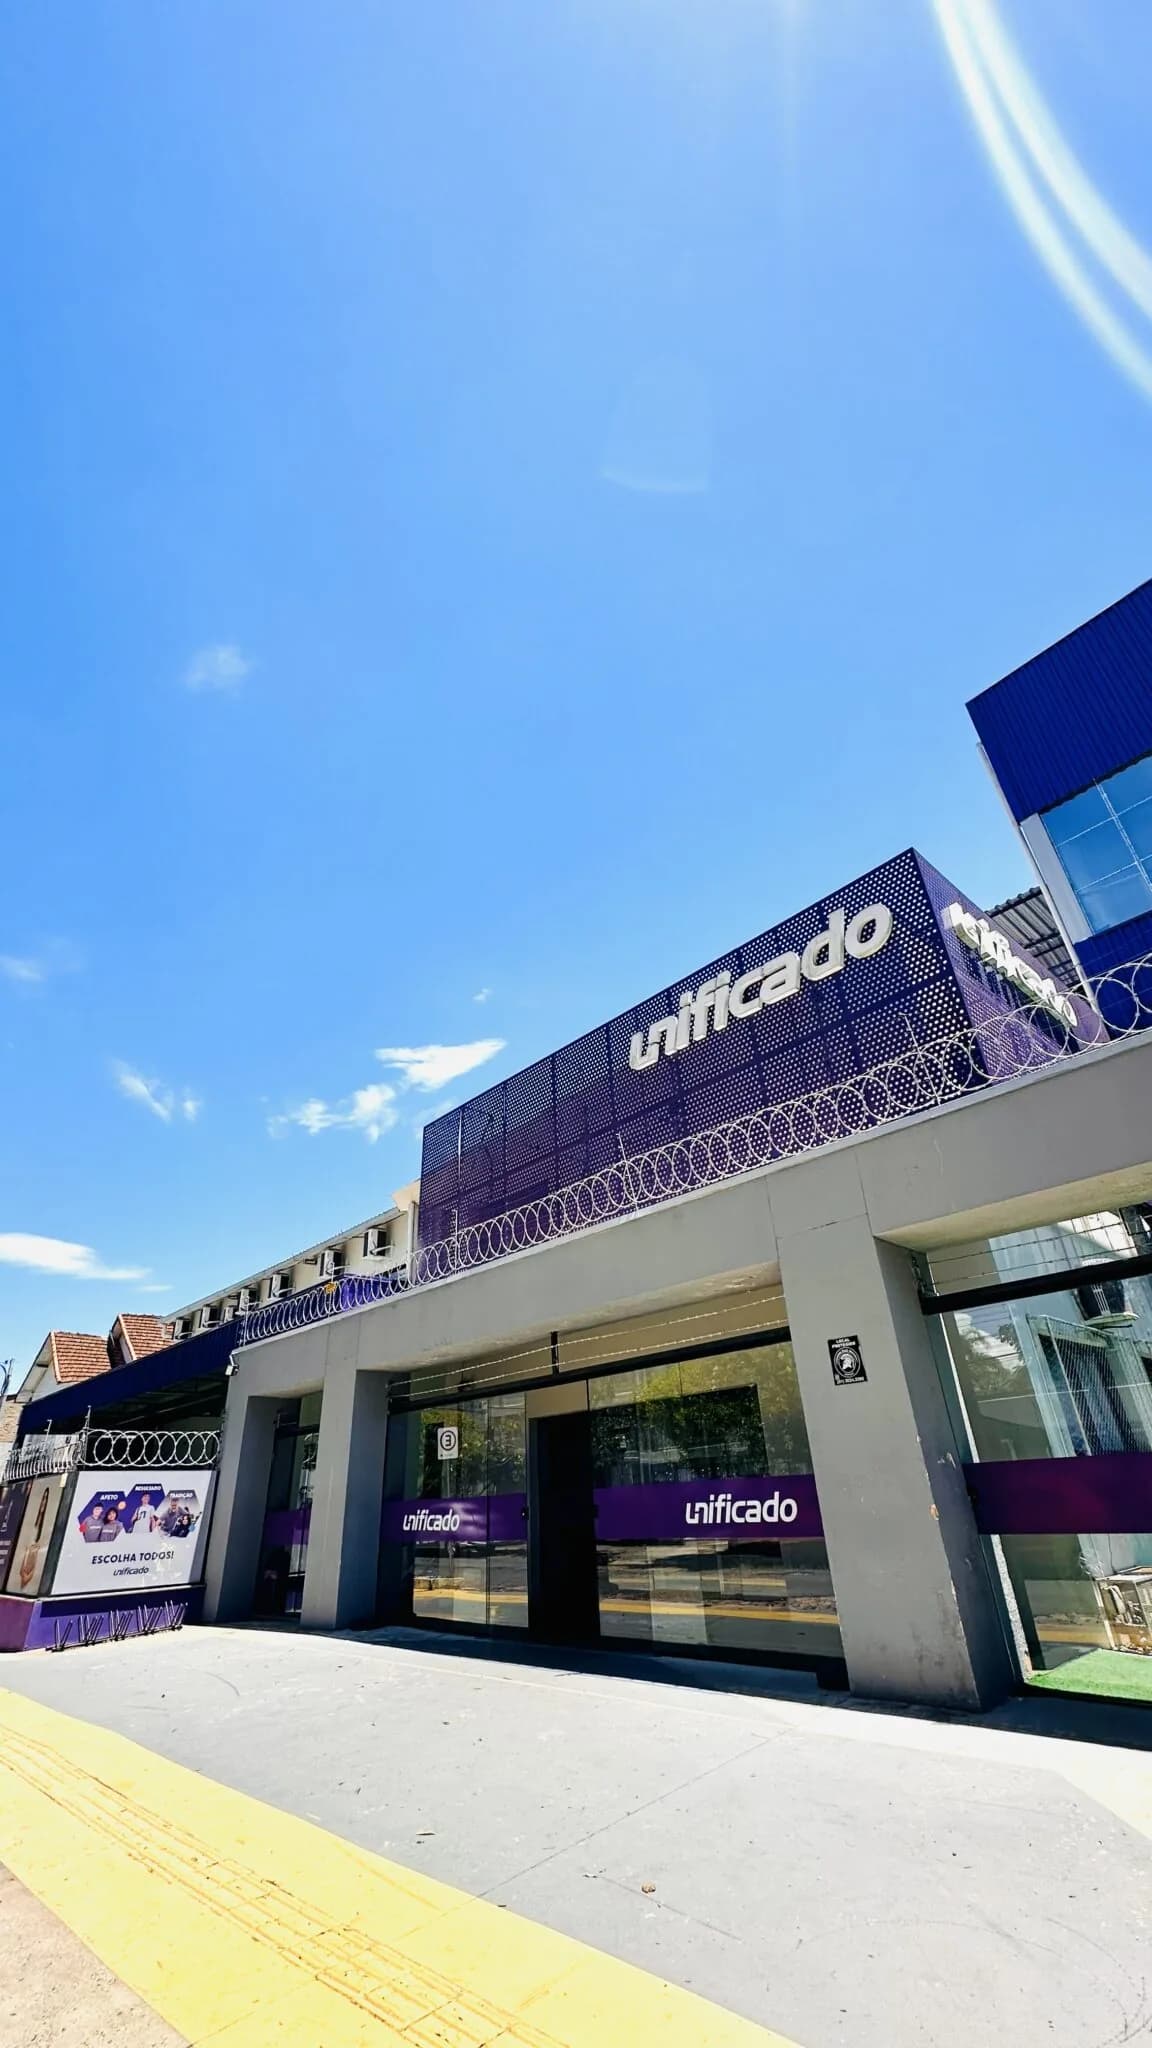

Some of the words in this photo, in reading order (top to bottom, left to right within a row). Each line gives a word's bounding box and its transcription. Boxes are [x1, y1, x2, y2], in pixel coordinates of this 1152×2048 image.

[629, 902, 893, 1071] unificado
[685, 1491, 798, 1524] unificado
[402, 1508, 460, 1531] unificado
[91, 1553, 136, 1565] ESCOLHA
[139, 1550, 174, 1561] TODOS!
[113, 1566, 149, 1576] unificado
